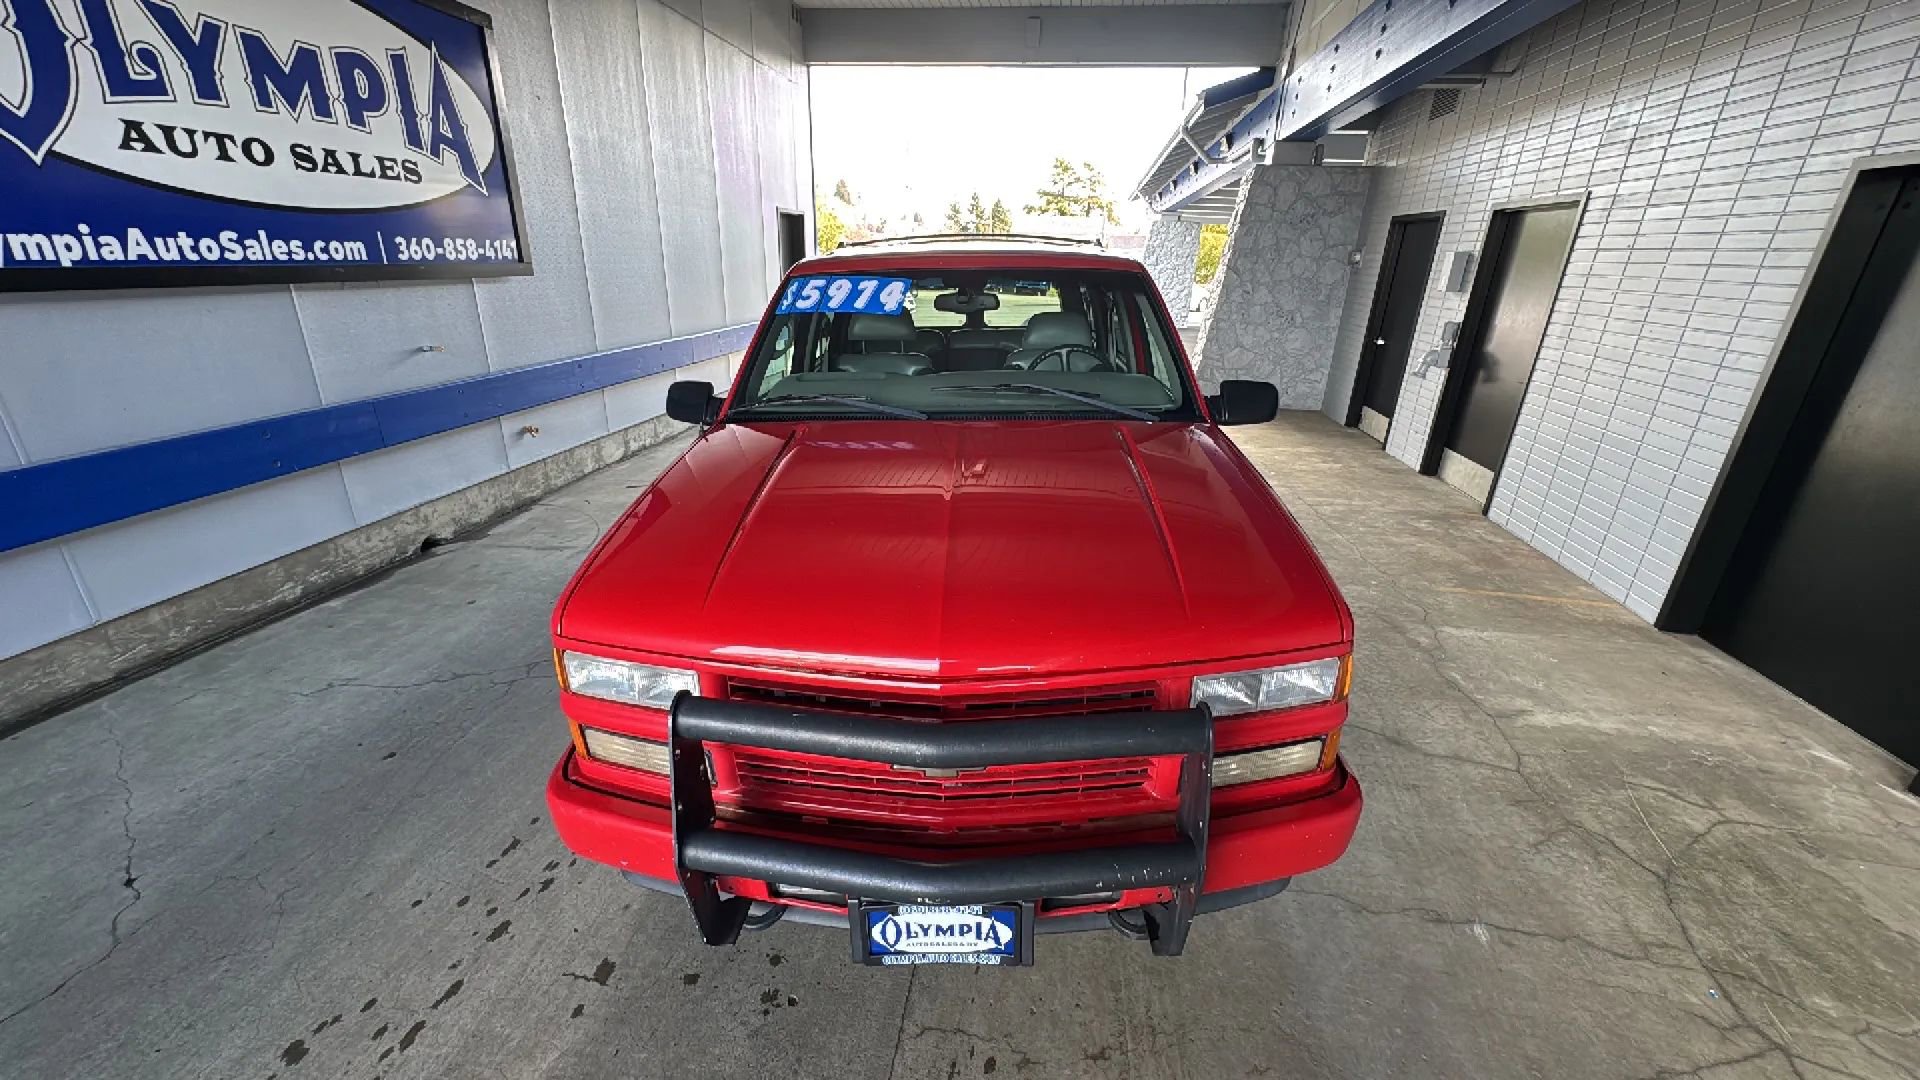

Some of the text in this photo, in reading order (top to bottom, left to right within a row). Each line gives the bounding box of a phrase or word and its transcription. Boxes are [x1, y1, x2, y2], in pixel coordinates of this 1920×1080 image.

[118, 118, 423, 185] AUTO SALES
[0, 224, 518, 268] mpiaAutoSales.com 360-858-4141
[880, 915, 1004, 950] OLYMPIA
